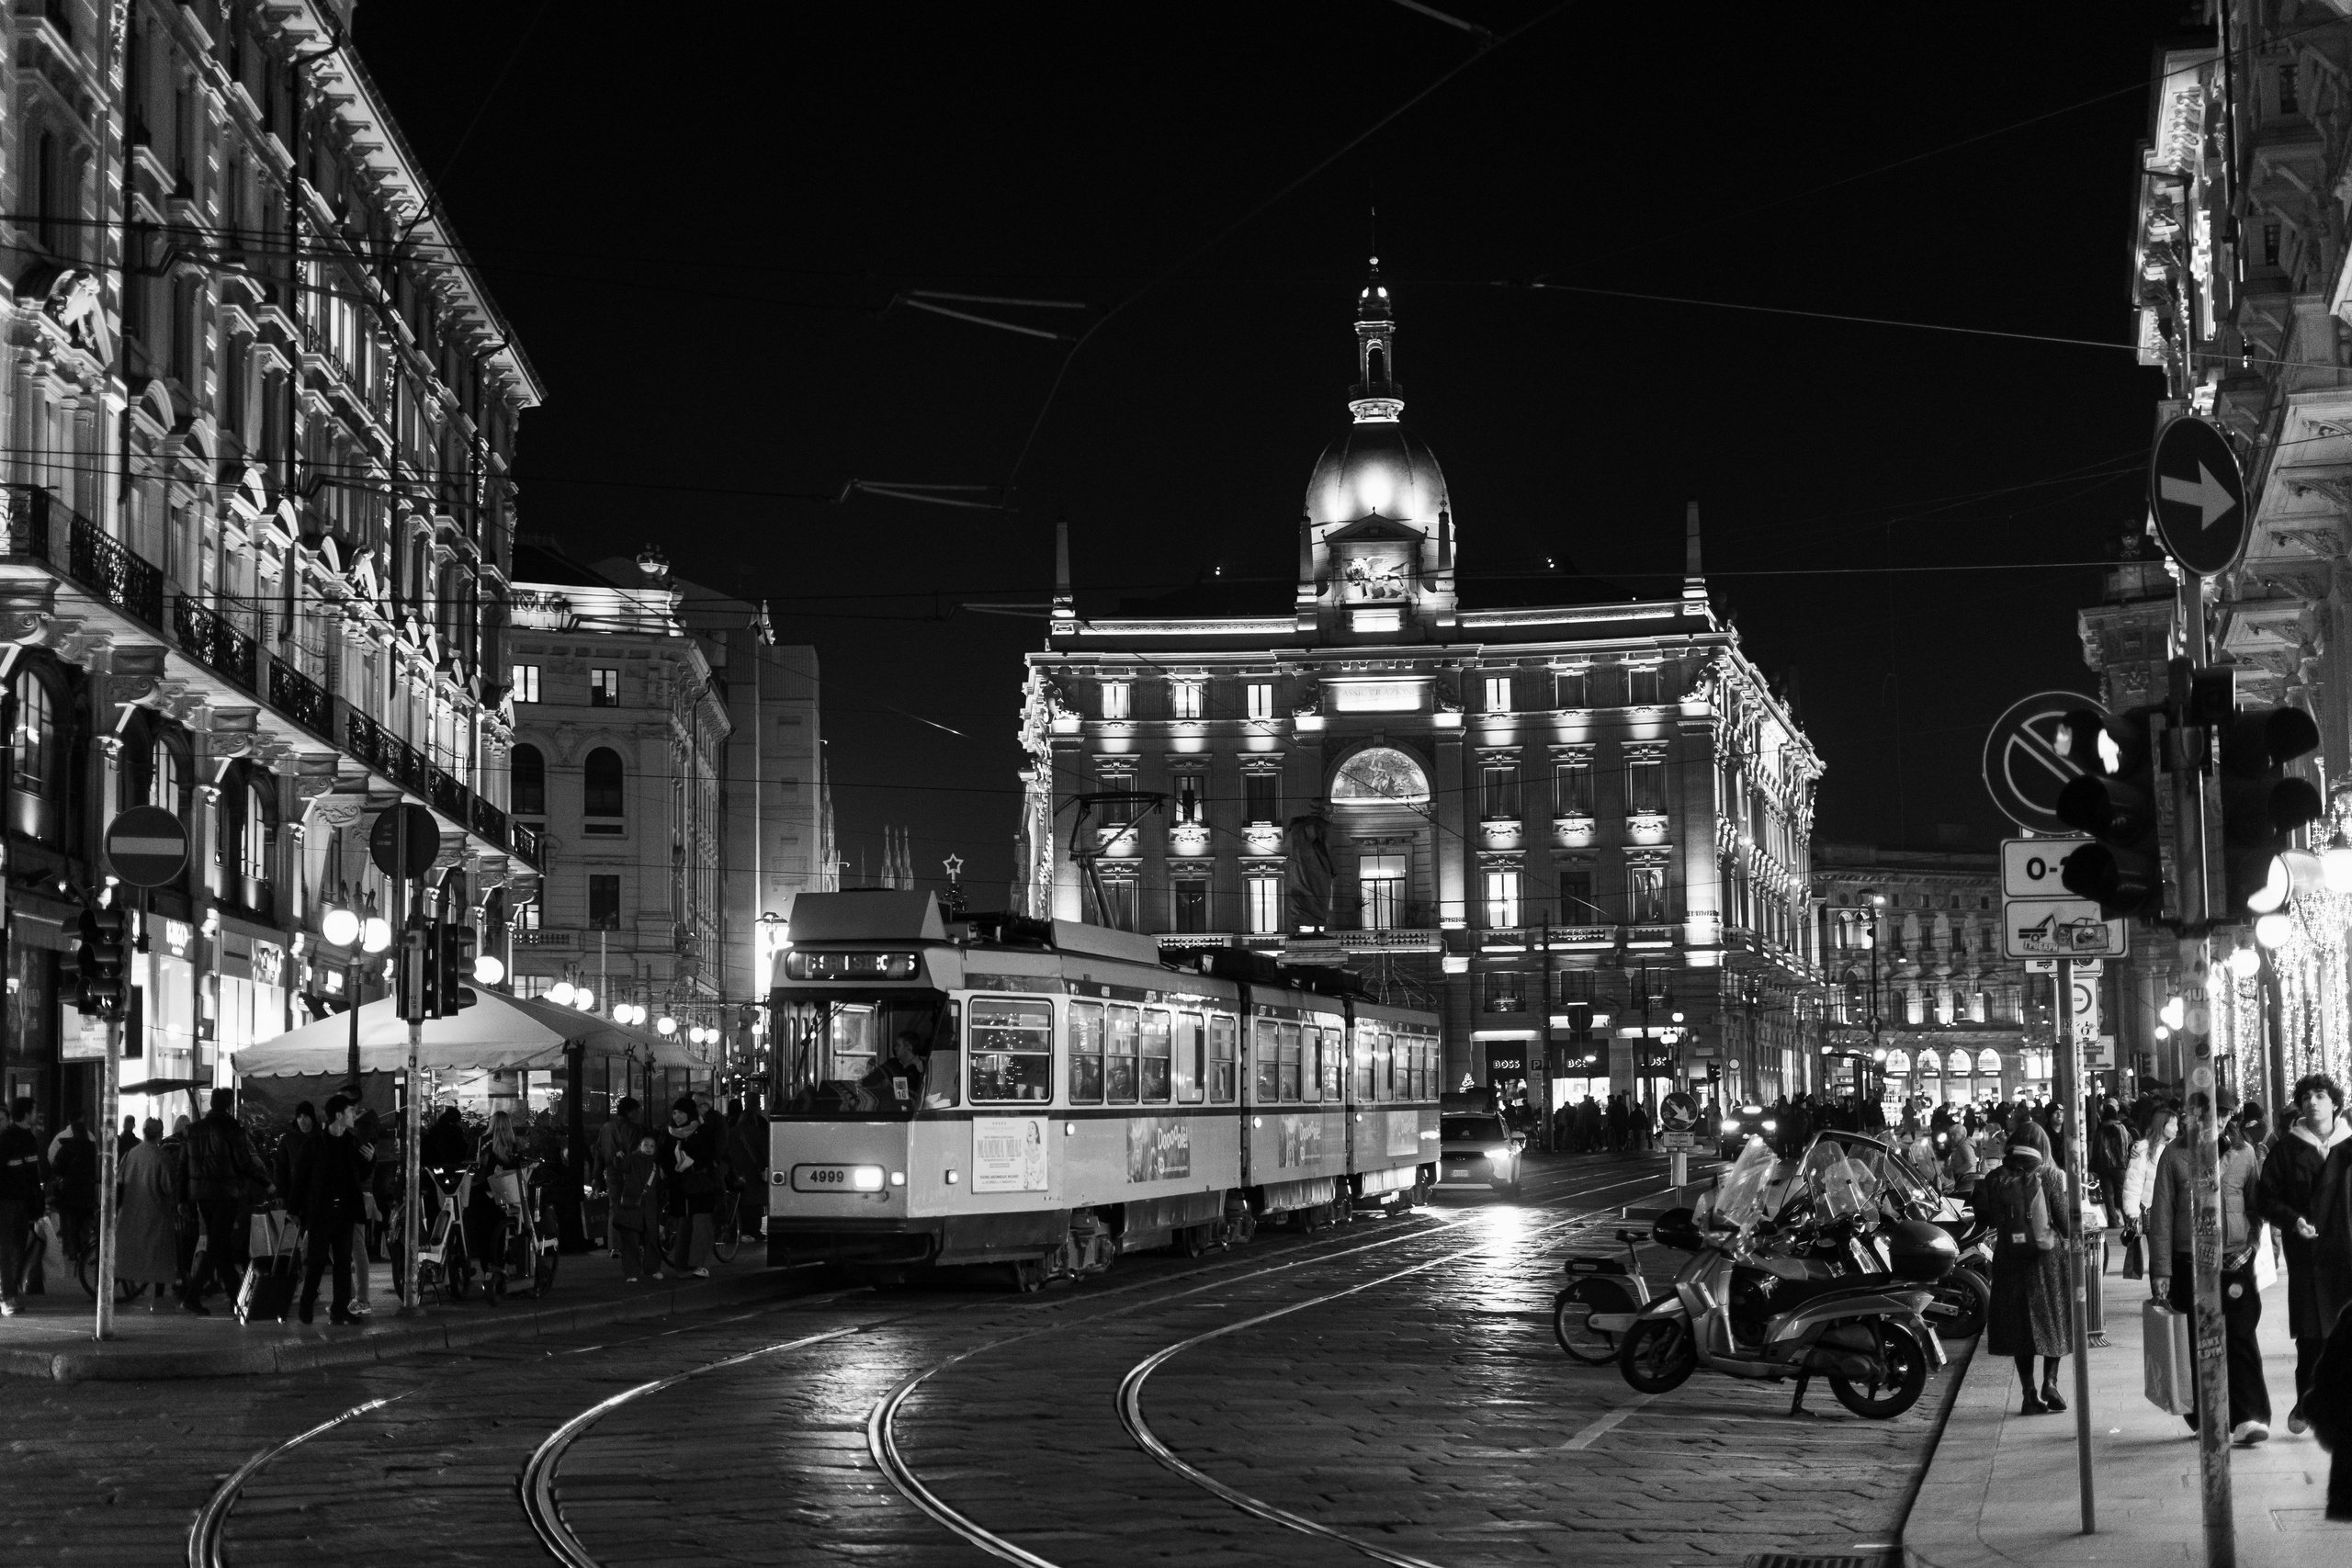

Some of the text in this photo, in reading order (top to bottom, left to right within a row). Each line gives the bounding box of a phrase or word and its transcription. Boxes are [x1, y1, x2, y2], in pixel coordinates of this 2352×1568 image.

[2026, 856, 2069, 880] 0-
[1493, 1059, 1521, 1068] BOSS
[1532, 1060, 1541, 1069] P
[898, 1089, 907, 1099] 16
[809, 1170, 844, 1183] 4999
